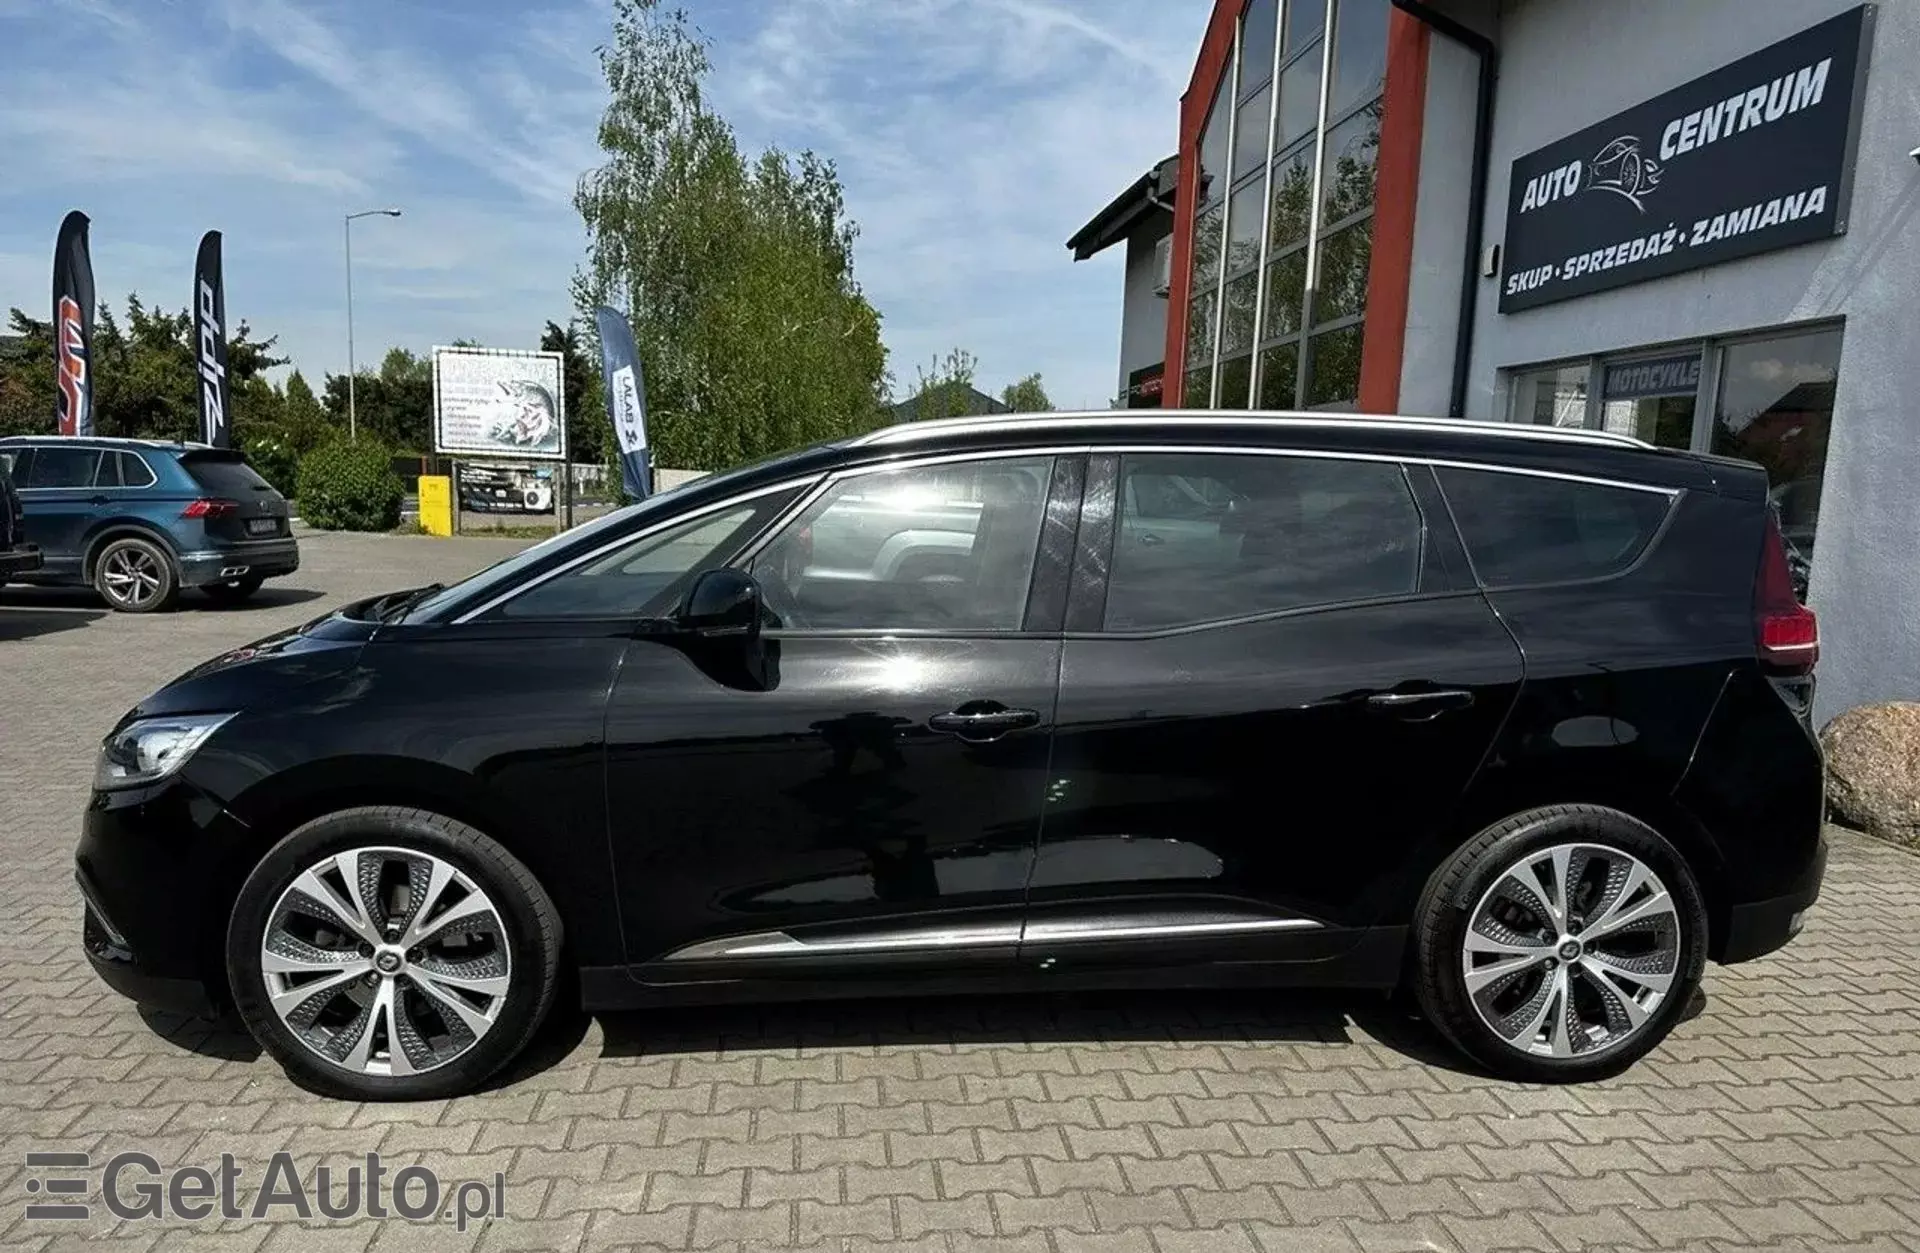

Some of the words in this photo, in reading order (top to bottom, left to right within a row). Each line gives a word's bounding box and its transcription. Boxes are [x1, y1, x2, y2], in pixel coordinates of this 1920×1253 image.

[1520, 160, 1582, 213] AUTO
[1659, 57, 1832, 161] CENTRUM
[1506, 264, 1553, 295] SKUP
[1562, 222, 1677, 280] SPRZEDAŻ
[1690, 186, 1827, 246] ZAMIANA
[1607, 359, 1701, 393] MOTOCYKLE
